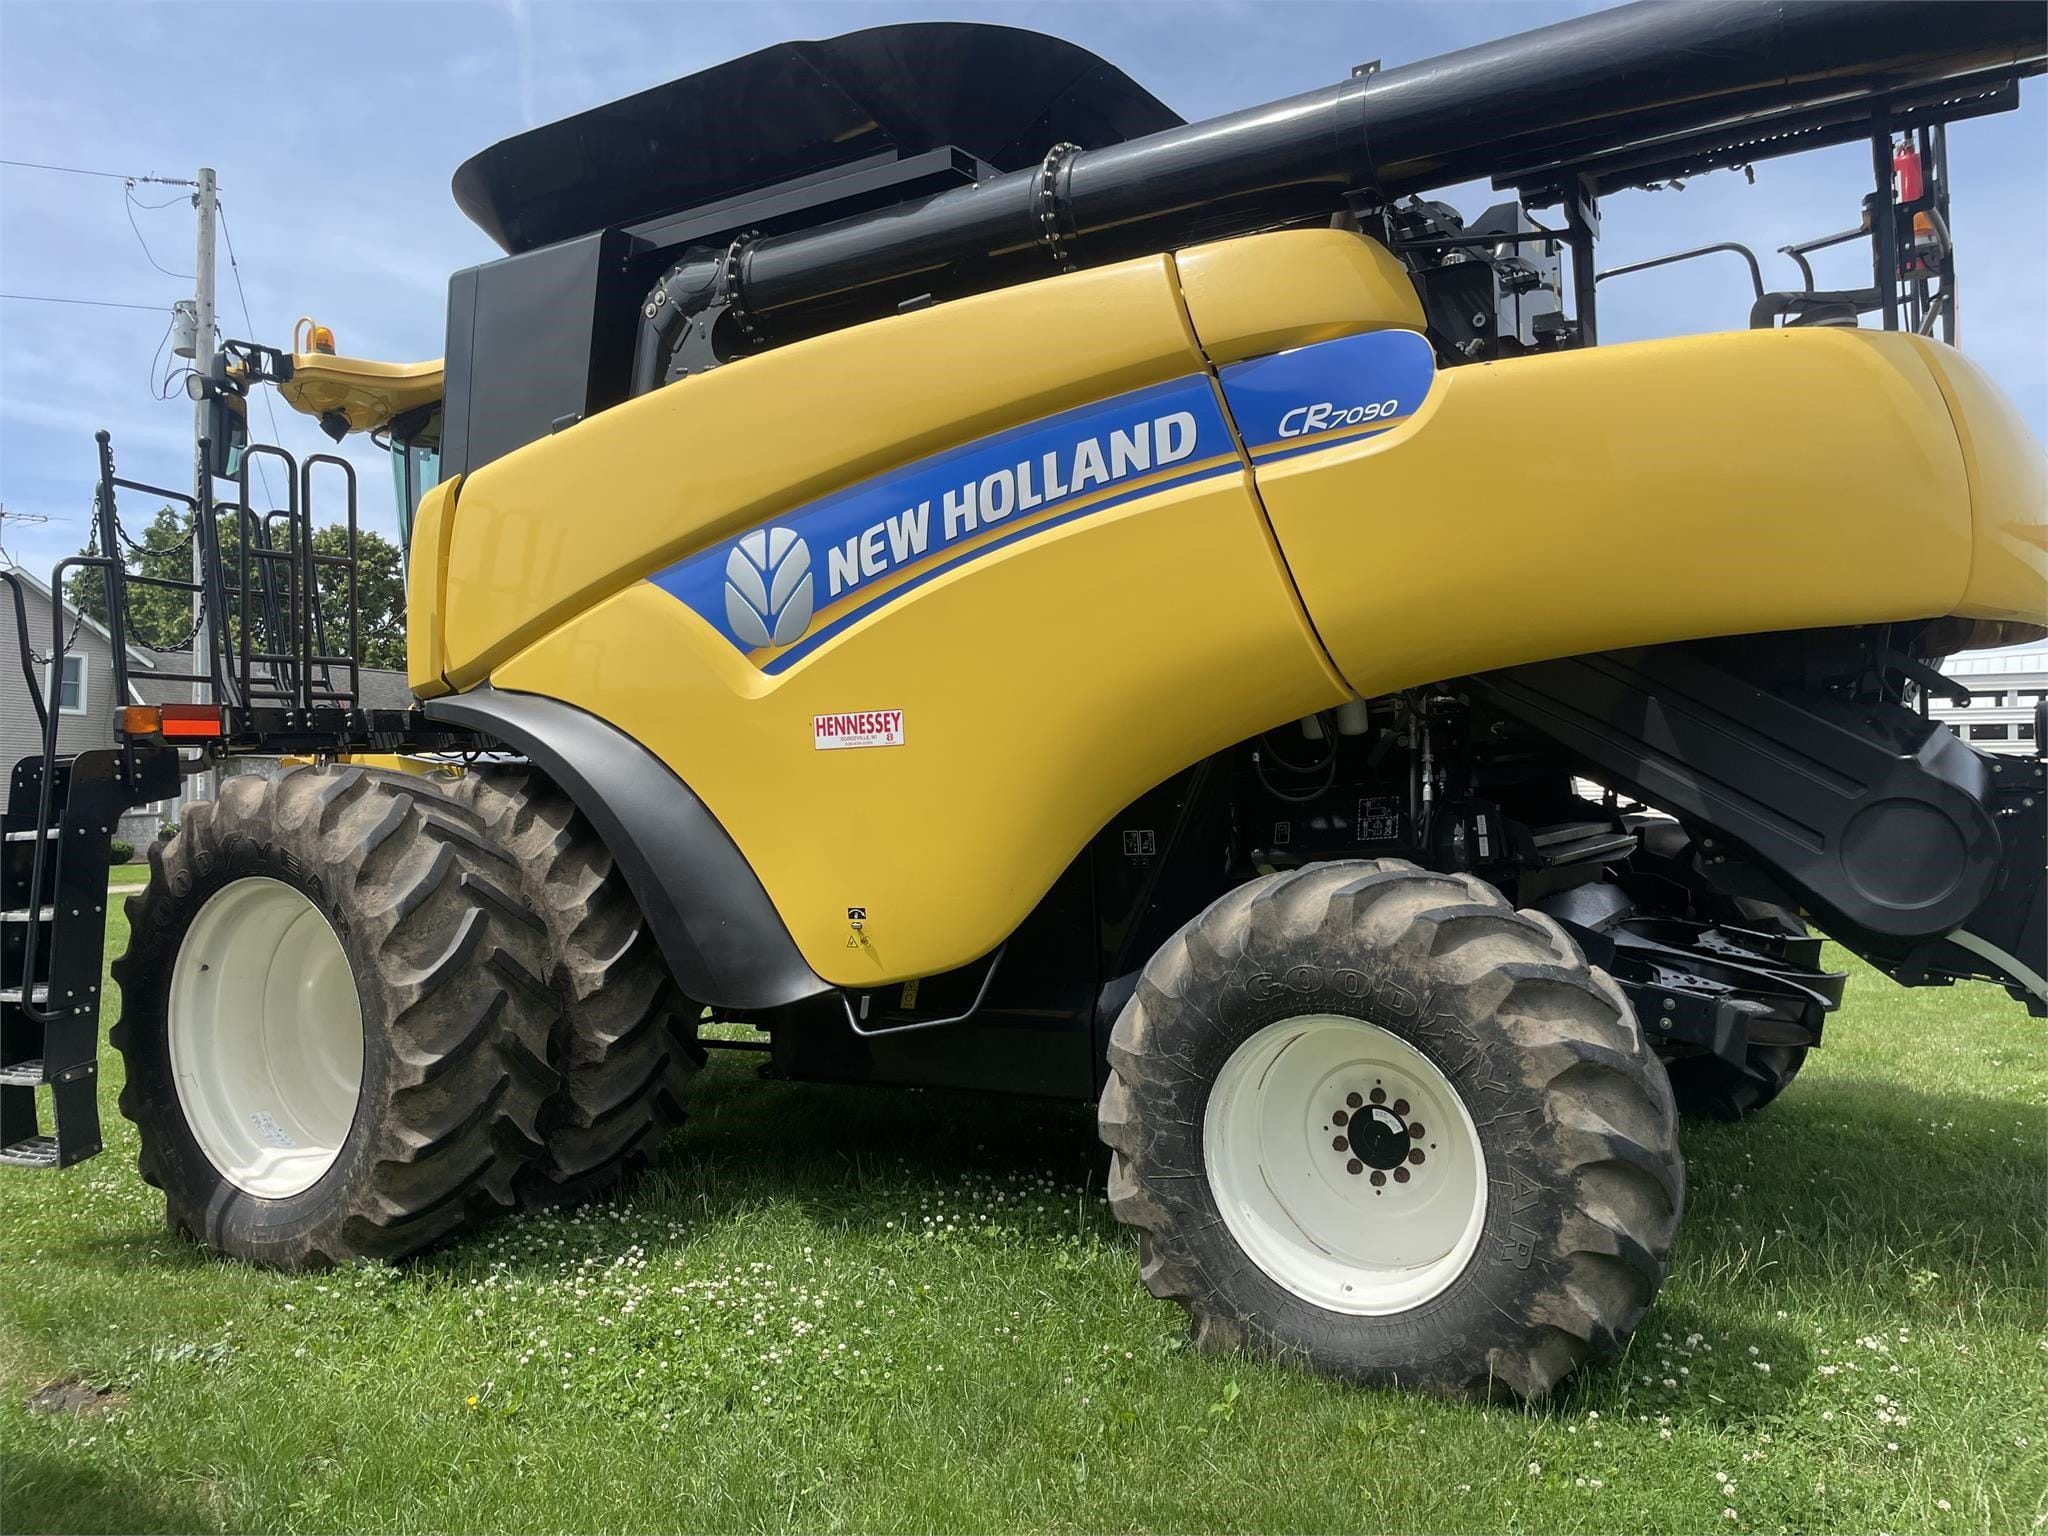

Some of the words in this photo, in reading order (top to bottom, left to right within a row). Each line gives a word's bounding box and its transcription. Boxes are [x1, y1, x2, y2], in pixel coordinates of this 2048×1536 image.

[1278, 399, 1399, 437] CR7090
[827, 501, 930, 597] NEW
[942, 411, 1198, 540] HOLLAND
[815, 712, 901, 737] HENNESSEY
